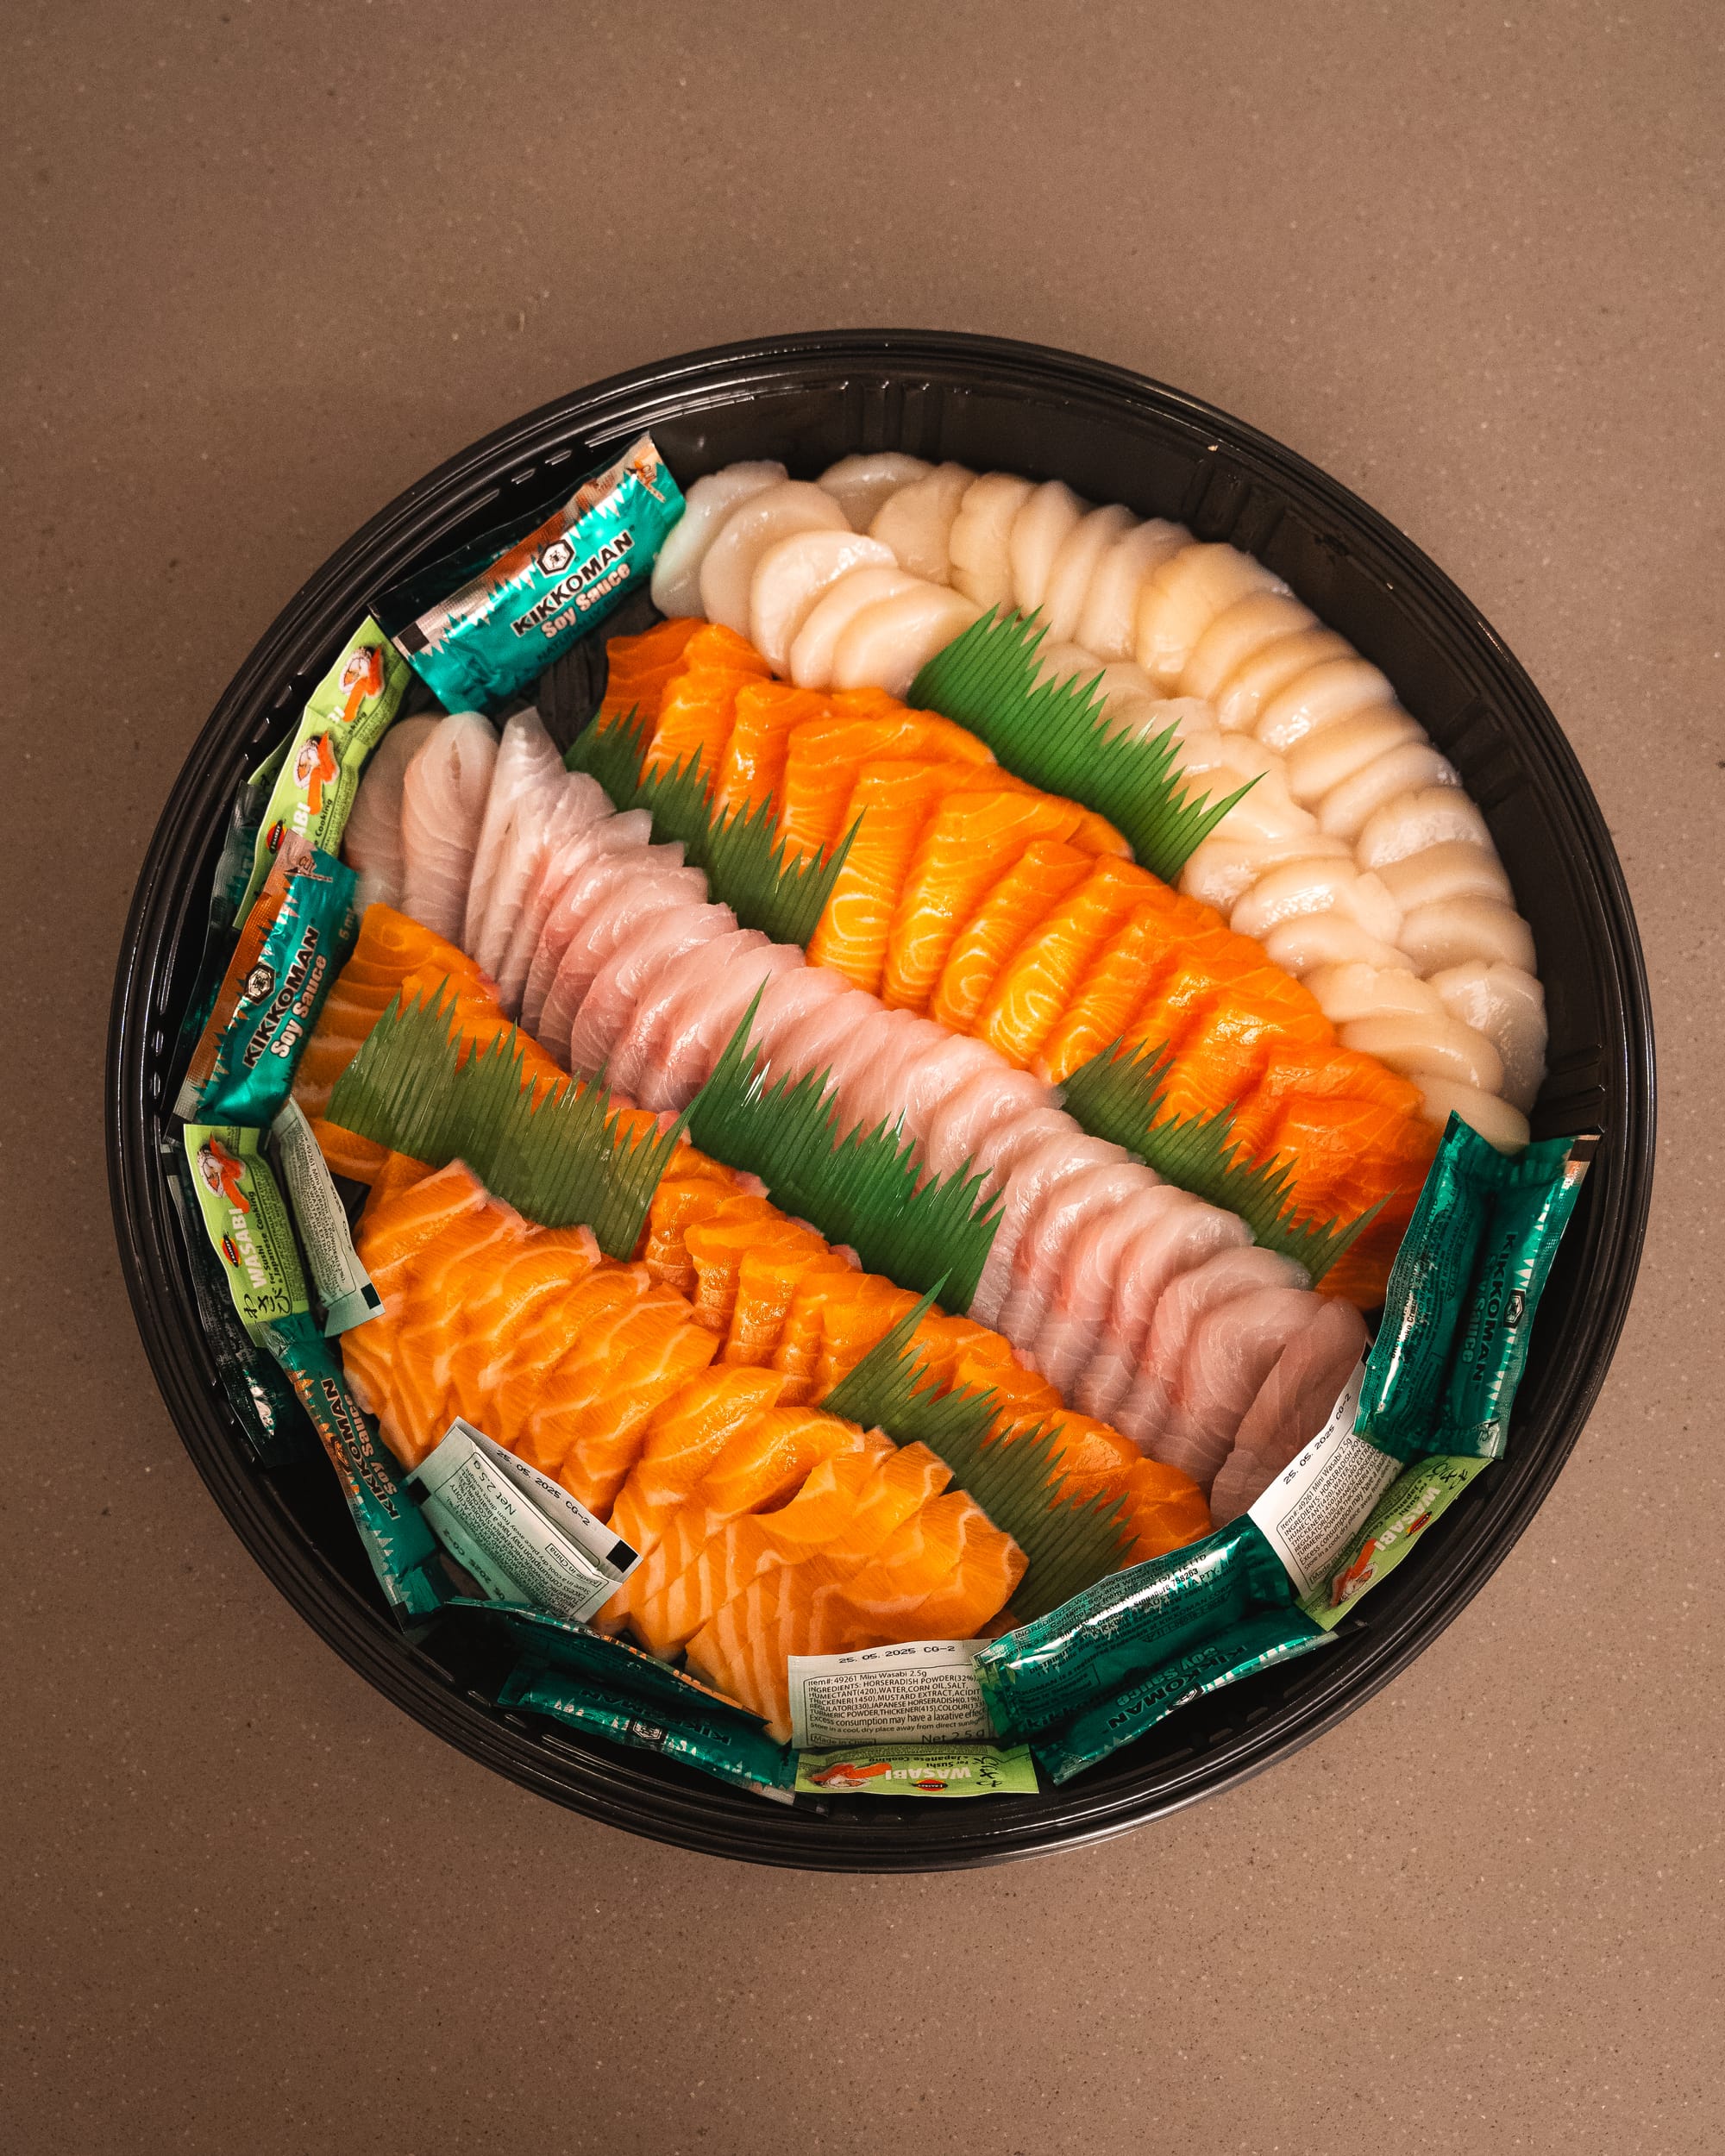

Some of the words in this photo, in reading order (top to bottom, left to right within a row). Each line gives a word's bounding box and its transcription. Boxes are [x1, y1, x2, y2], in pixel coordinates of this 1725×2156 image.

[509, 529, 636, 638] KIKKOMAN
[538, 603, 581, 641] Soy
[573, 560, 634, 613] Sauce
[240, 924, 320, 1069] KIKKOMAN
[268, 1018, 306, 1059] Soy
[291, 953, 328, 1018] Sauce
[247, 1189, 265, 1231] Cooking
[227, 1206, 268, 1288] WASABI
[255, 1244, 271, 1271] Sushi
[260, 1232, 282, 1277] Japanese
[267, 1270, 277, 1284] For
[240, 1284, 292, 1321] わさび
[1471, 1232, 1517, 1383] KIKKOMAN
[1459, 1296, 1487, 1364] Sauce
[342, 1390, 376, 1458] Sauce
[319, 1376, 401, 1520] KIKKOMAN
[1281, 1468, 1299, 1485] 25.
[1313, 1423, 1336, 1451] 2025
[367, 1457, 399, 1496] Soy
[471, 1457, 481, 1472] g
[1295, 1490, 1315, 1512] 49261
[1310, 1475, 1326, 1492] Mini
[1320, 1451, 1344, 1477] Wasabi
[1339, 1437, 1354, 1453] 2.5g
[1318, 1450, 1354, 1496] HORSERADISH
[477, 1470, 497, 1494] 2.5
[533, 1476, 562, 1500] 2025
[467, 1488, 494, 1520] laxative
[493, 1489, 518, 1517] Net
[1383, 1482, 1420, 1521] Japanese
[1397, 1494, 1420, 1517] Sushi
[495, 1508, 511, 1526] from
[495, 1518, 511, 1539] have
[509, 1520, 526, 1540] away
[1298, 1544, 1324, 1565] Excess
[1317, 1504, 1355, 1547] consumption
[1350, 1490, 1365, 1507] may
[1358, 1476, 1374, 1493] have
[1372, 1482, 1441, 1553] WASABI
[508, 1530, 527, 1551] may
[1295, 1528, 1327, 1557] TURMERIC
[1302, 1553, 1320, 1571] Store
[1338, 1522, 1352, 1536] dry
[1346, 1507, 1362, 1525] place
[1358, 1492, 1374, 1510] away
[524, 1537, 541, 1557] place
[537, 1551, 550, 1567] dry
[547, 1545, 569, 1570] China
[524, 1544, 564, 1589] consumption
[1170, 1567, 1200, 1586] 758263
[561, 1582, 586, 1602] Excess
[884, 1647, 916, 1657] 2025
[1178, 1644, 1218, 1672] Soy
[807, 1683, 861, 1693] INGREDIENTS:
[863, 1677, 918, 1686] HORSERADISH
[833, 1675, 856, 1683] 49261
[877, 1670, 906, 1678] Wasabi
[1102, 1644, 1248, 1732] KIKKOMAN
[1113, 1665, 1178, 1709] Sauce
[809, 1714, 833, 1724] Excess
[835, 1717, 888, 1727] consumption
[889, 1717, 905, 1726] may
[907, 1714, 925, 1722] have
[933, 1708, 963, 1720] laxative
[810, 1708, 846, 1718] TURMERIC
[813, 1734, 834, 1744] Made
[861, 1724, 874, 1733] dry
[884, 1765, 972, 1781] WASABI
